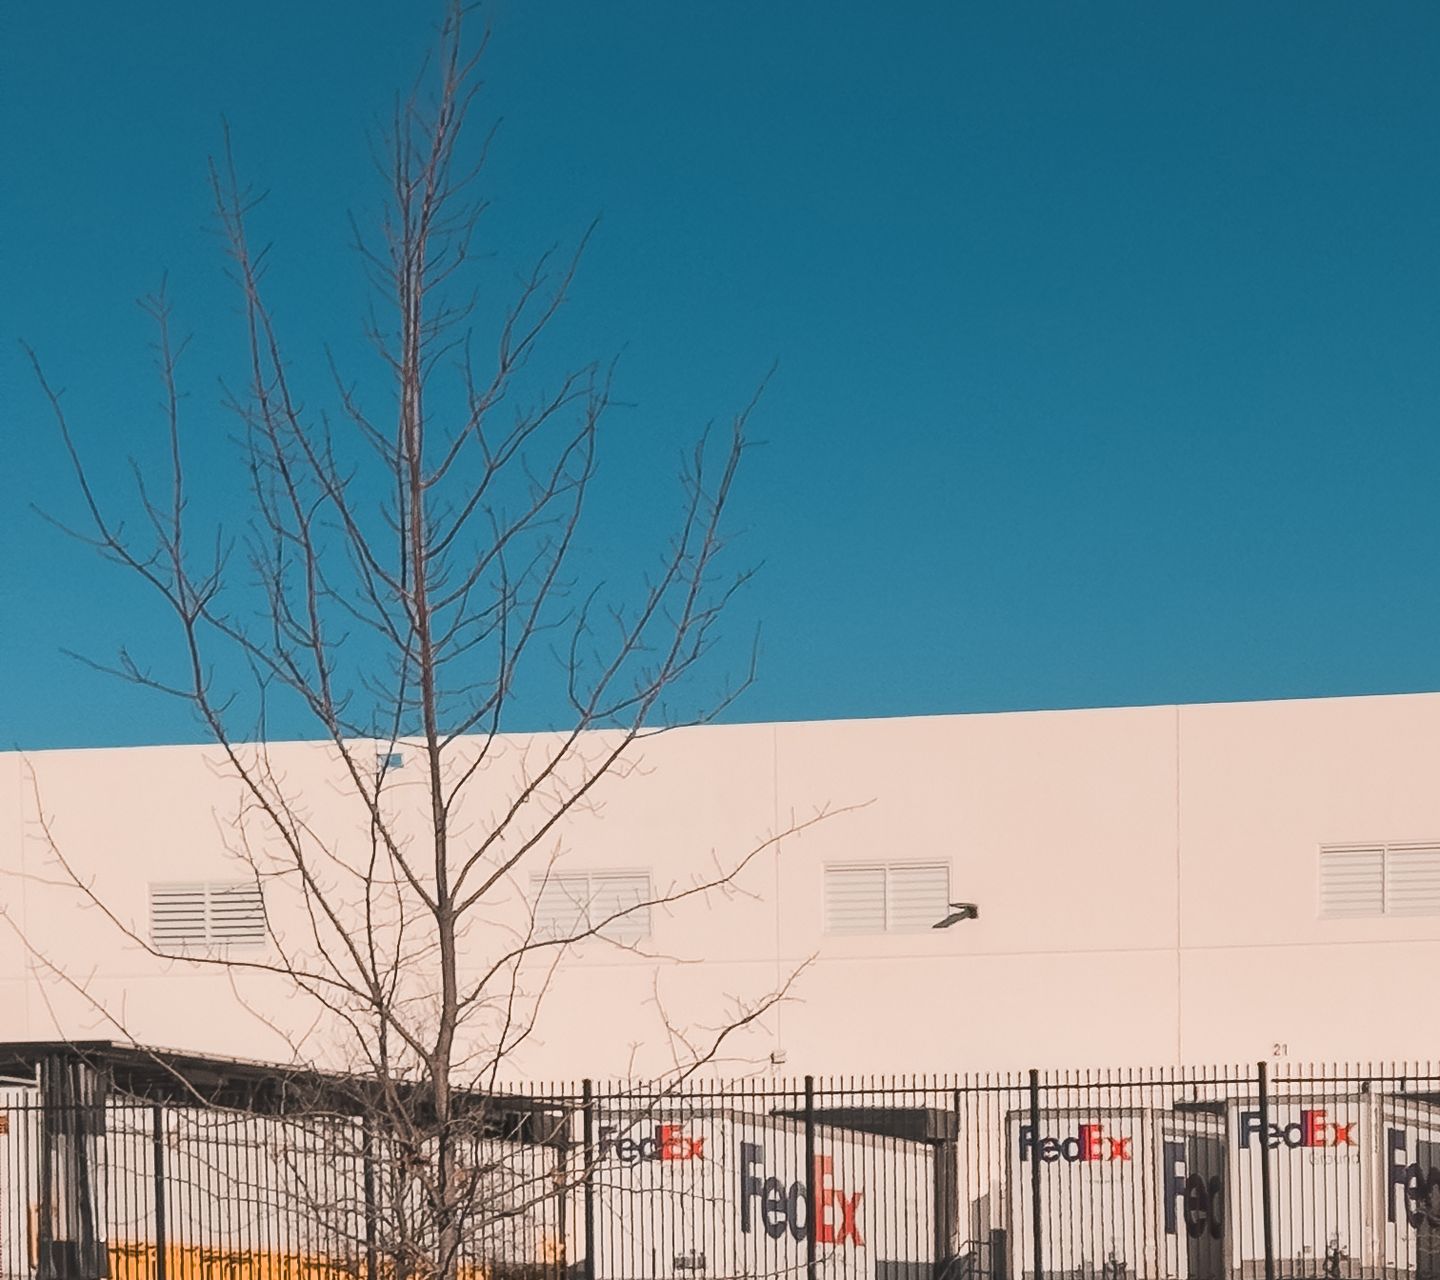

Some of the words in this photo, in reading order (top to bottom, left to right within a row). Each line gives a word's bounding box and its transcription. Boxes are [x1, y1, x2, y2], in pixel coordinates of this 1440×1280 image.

[1273, 1043, 1289, 1056] 21
[598, 1125, 704, 1162] FedEx
[1020, 1124, 1132, 1162] FedEx
[1240, 1109, 1357, 1149] FedEx
[741, 1141, 865, 1246] FedEx
